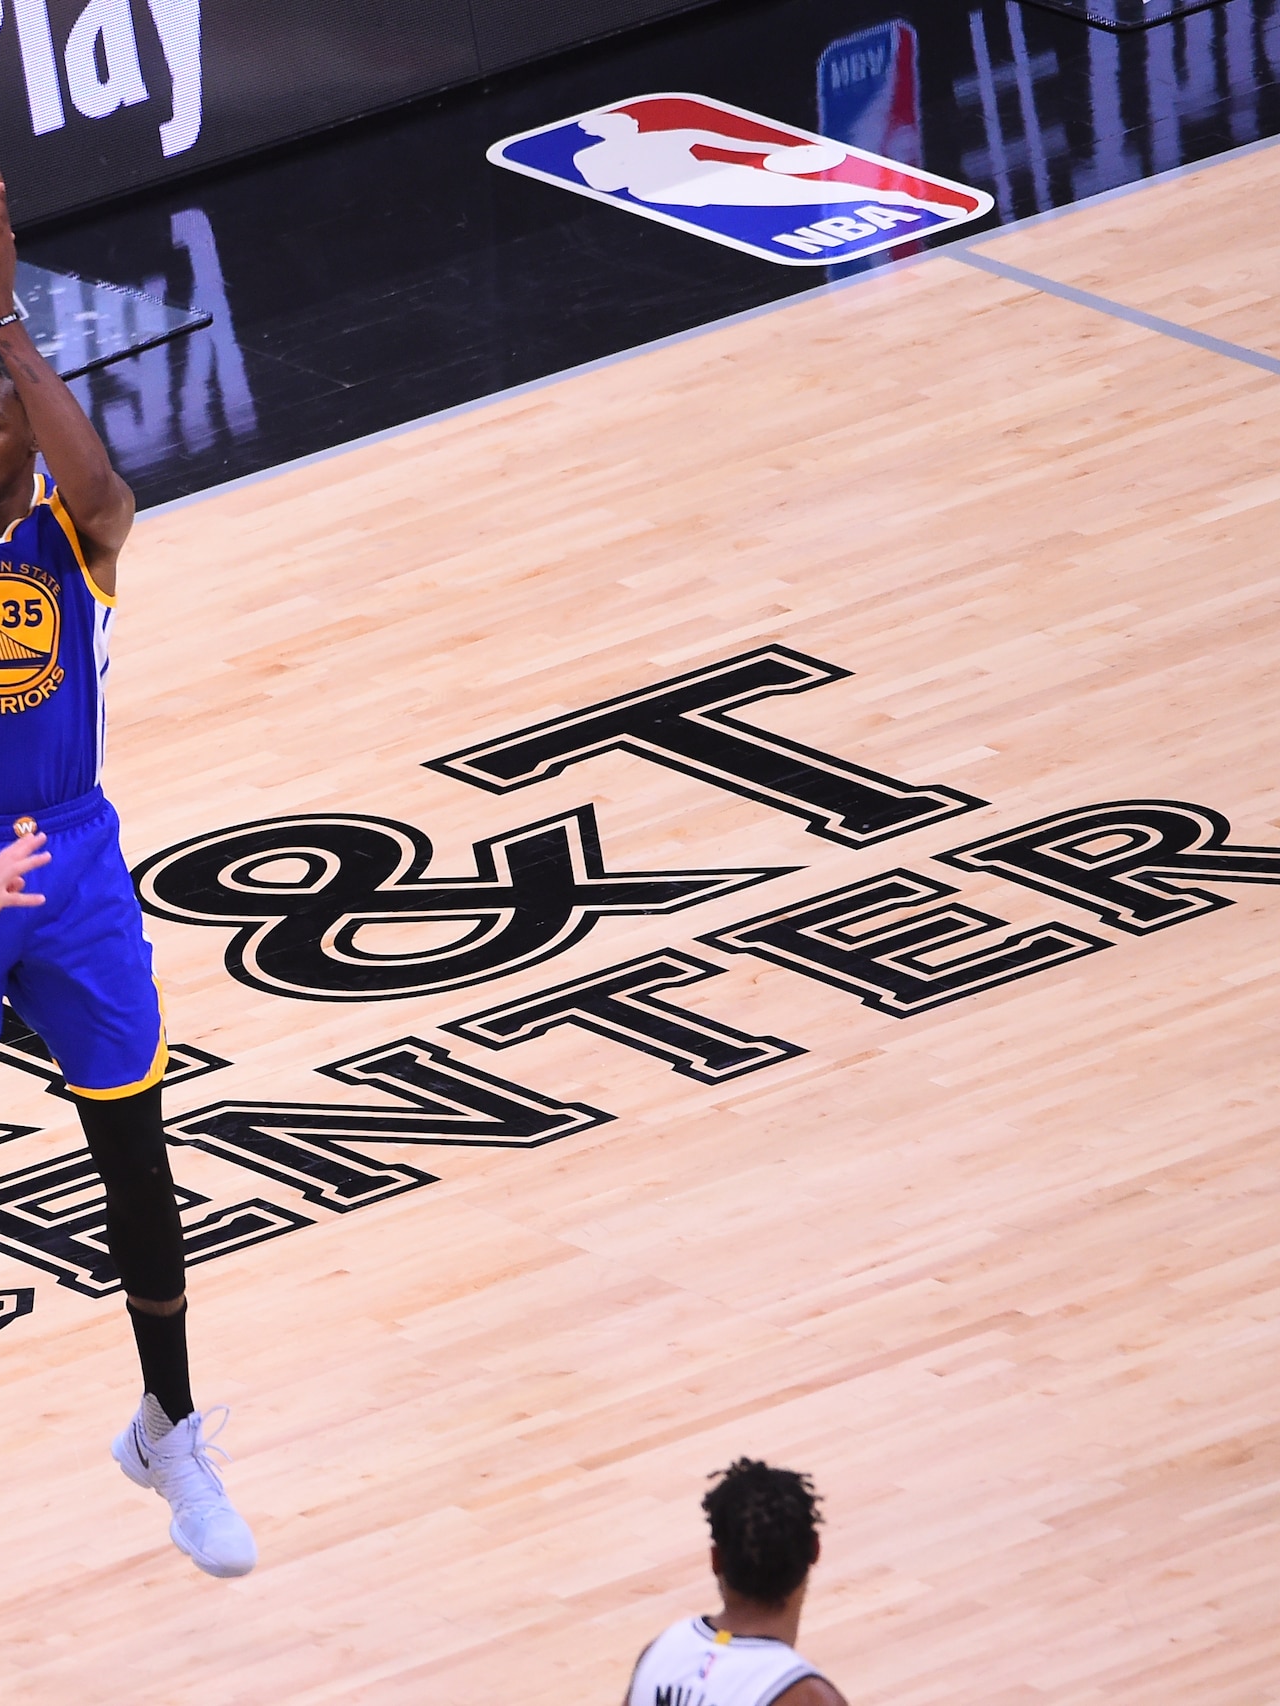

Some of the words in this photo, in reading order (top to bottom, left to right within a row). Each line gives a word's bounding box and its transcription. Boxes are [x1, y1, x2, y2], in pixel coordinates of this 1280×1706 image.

[771, 204, 923, 255] NBA
[19, 563, 62, 597] STATE
[1, 598, 43, 629] 35
